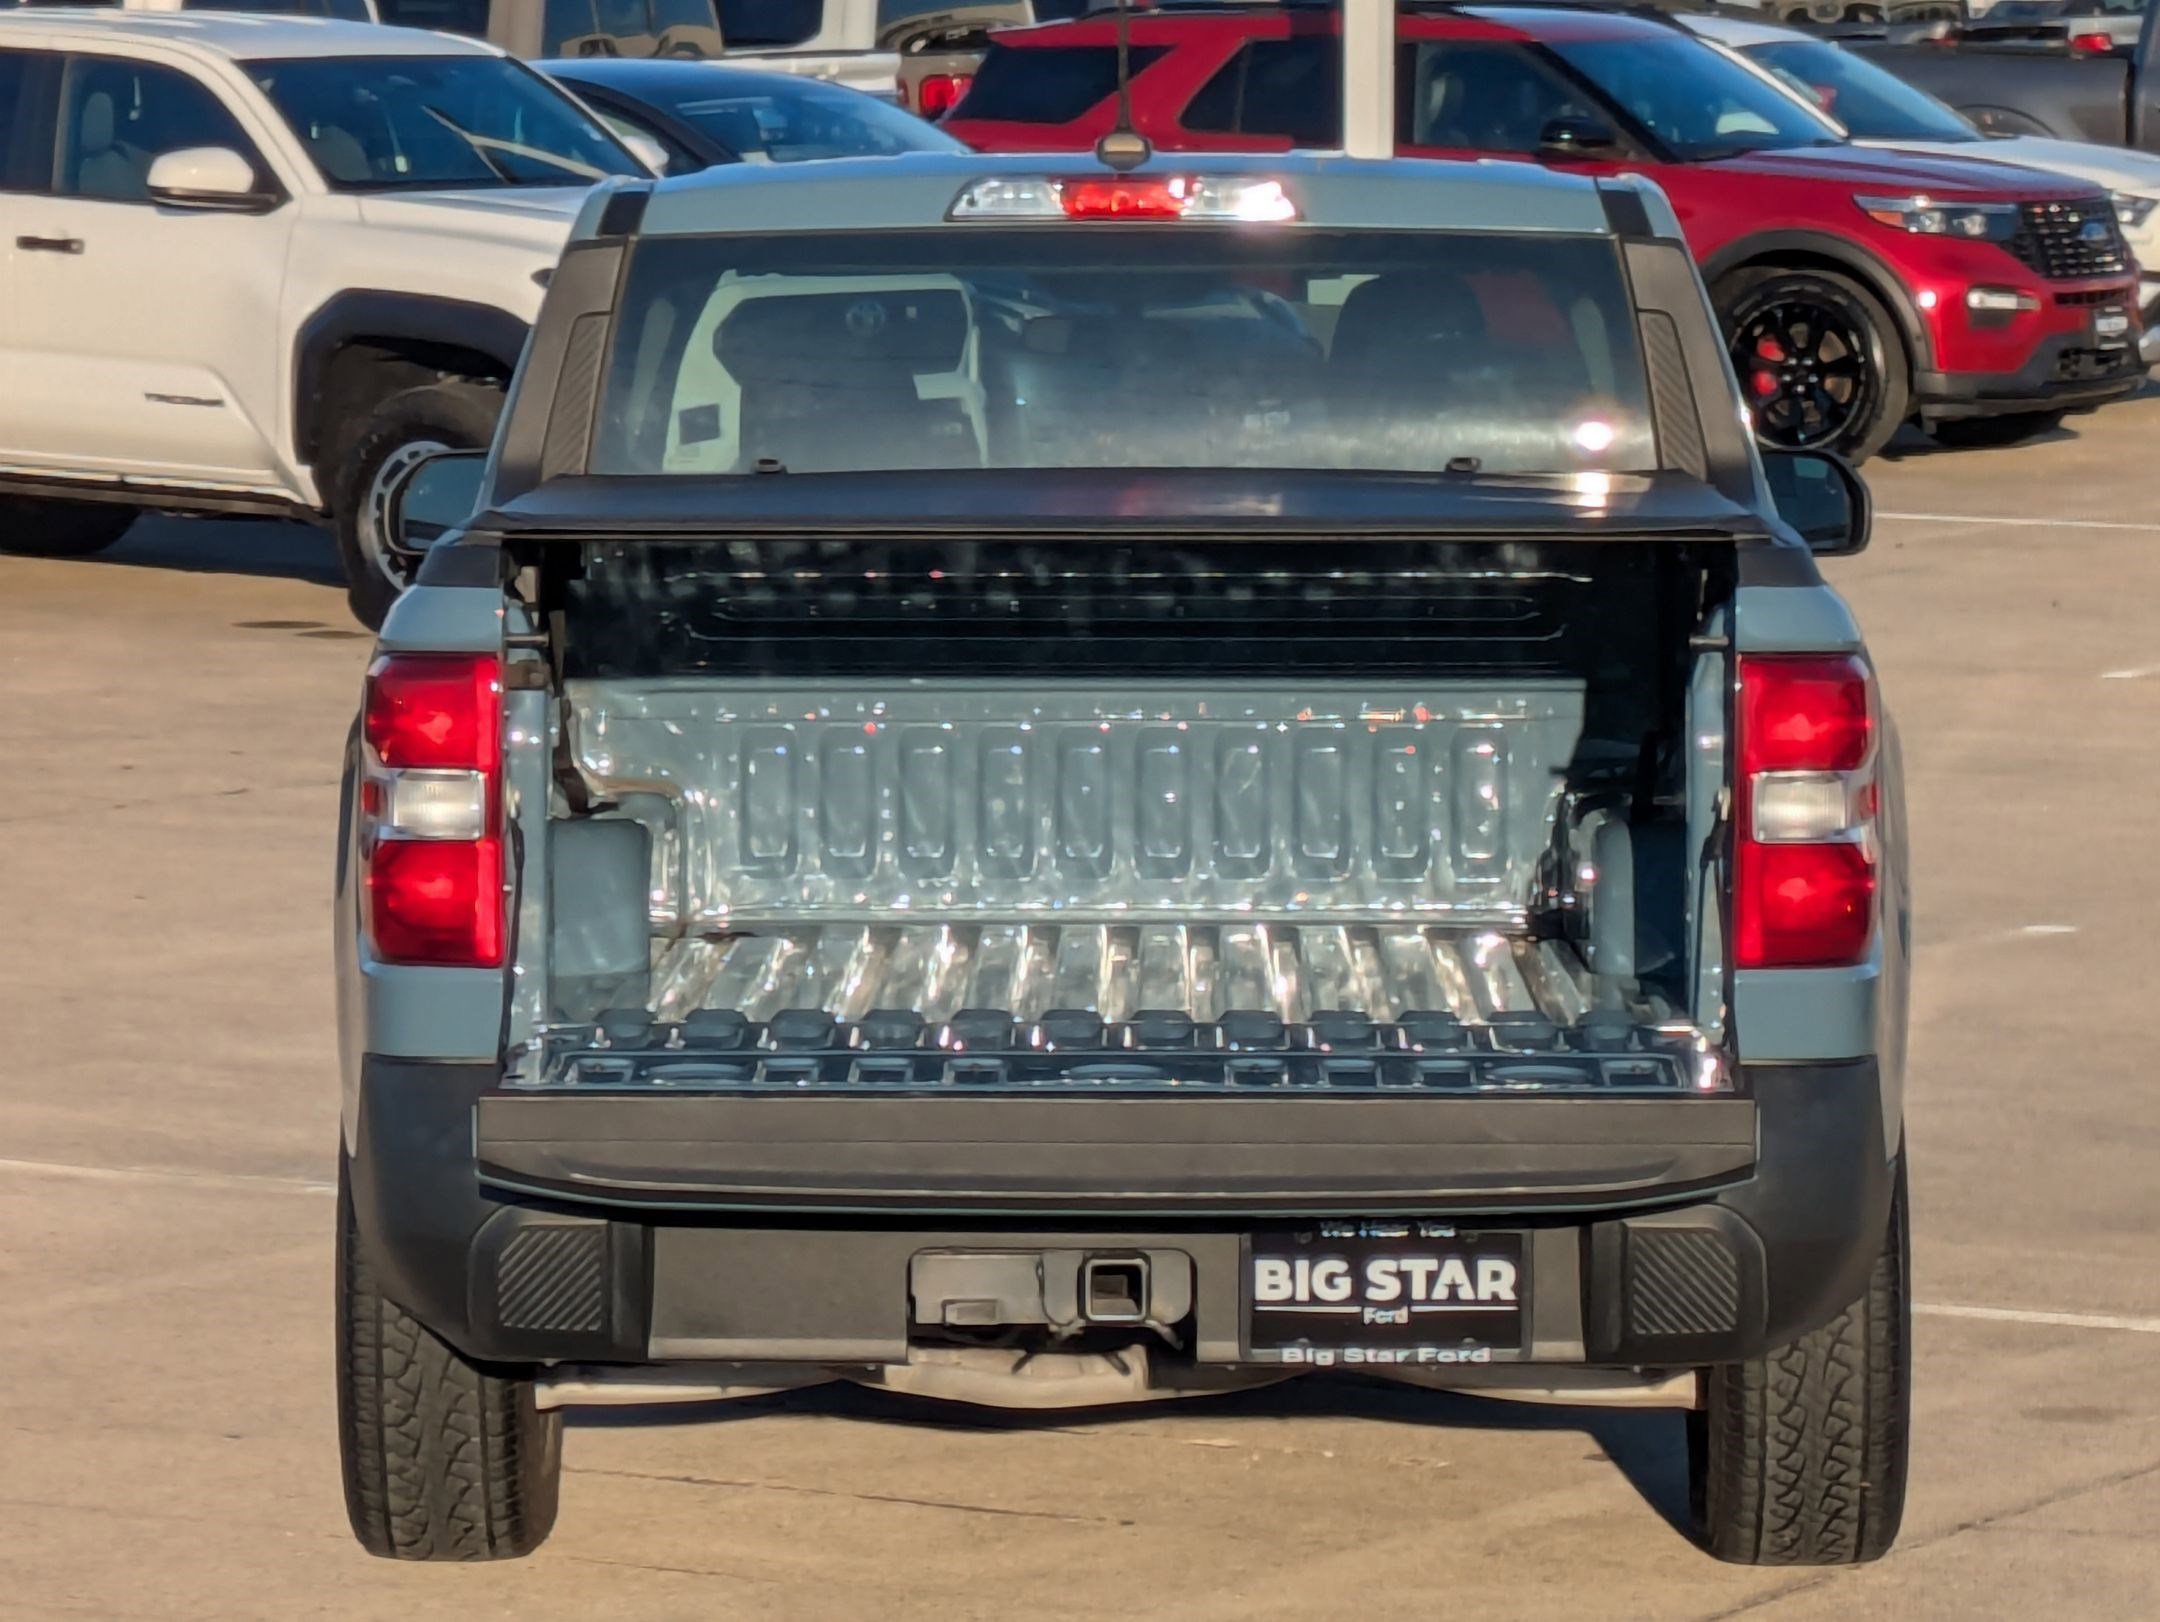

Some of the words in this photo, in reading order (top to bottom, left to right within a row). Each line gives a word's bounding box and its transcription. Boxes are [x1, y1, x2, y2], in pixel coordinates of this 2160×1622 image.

[1254, 1258, 1352, 1302] BIG
[1365, 1258, 1518, 1302] STAR
[1363, 1305, 1409, 1325] Ford
[1281, 1347, 1335, 1367] Big
[1343, 1347, 1411, 1364] Star
[1417, 1346, 1491, 1364] Ford
